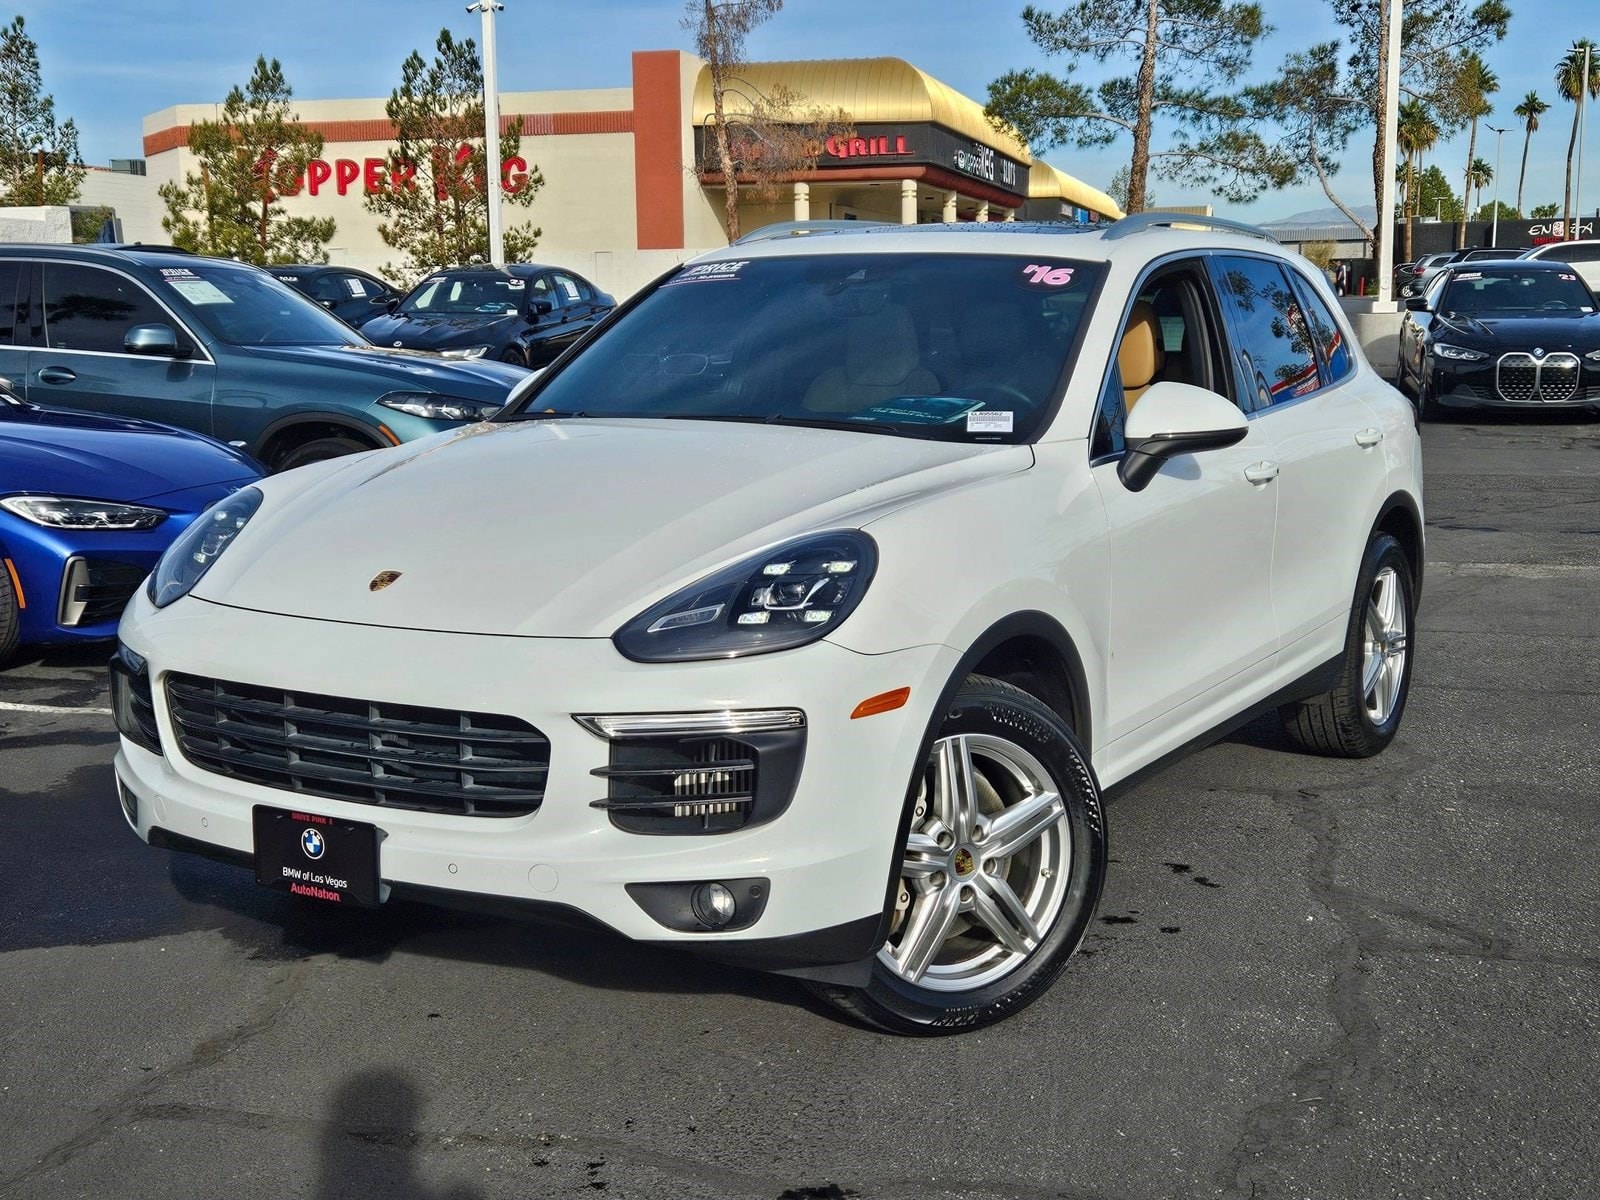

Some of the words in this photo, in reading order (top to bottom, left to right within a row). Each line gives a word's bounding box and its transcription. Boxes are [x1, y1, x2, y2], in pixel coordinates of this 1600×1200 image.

[825, 134, 915, 159] GRILL
[291, 812, 312, 822] DRIVE
[311, 815, 327, 824] PINK
[282, 866, 302, 879] BMW
[302, 871, 310, 881] of
[310, 872, 324, 884] Las
[324, 874, 348, 888] Vegas
